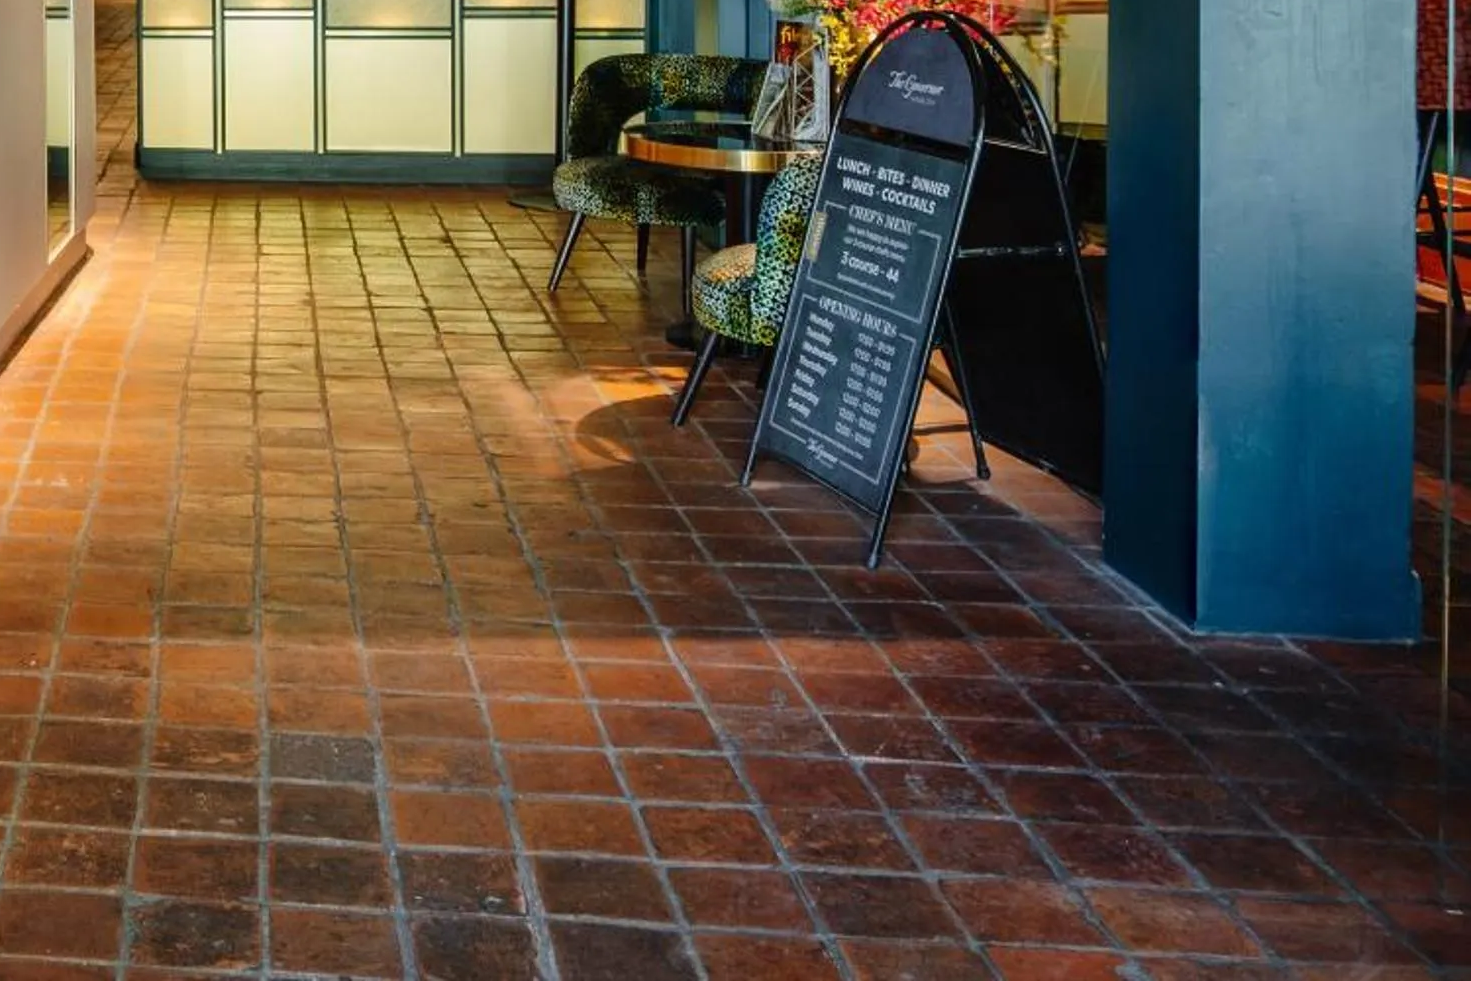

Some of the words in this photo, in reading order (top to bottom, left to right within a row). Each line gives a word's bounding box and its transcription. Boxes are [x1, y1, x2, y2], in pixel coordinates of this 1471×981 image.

[836, 156, 871, 176] LUNCH
[878, 166, 906, 185] BITES
[911, 175, 951, 198] DINNER
[842, 176, 875, 197] WINES
[882, 188, 937, 215] COCKTAILS
